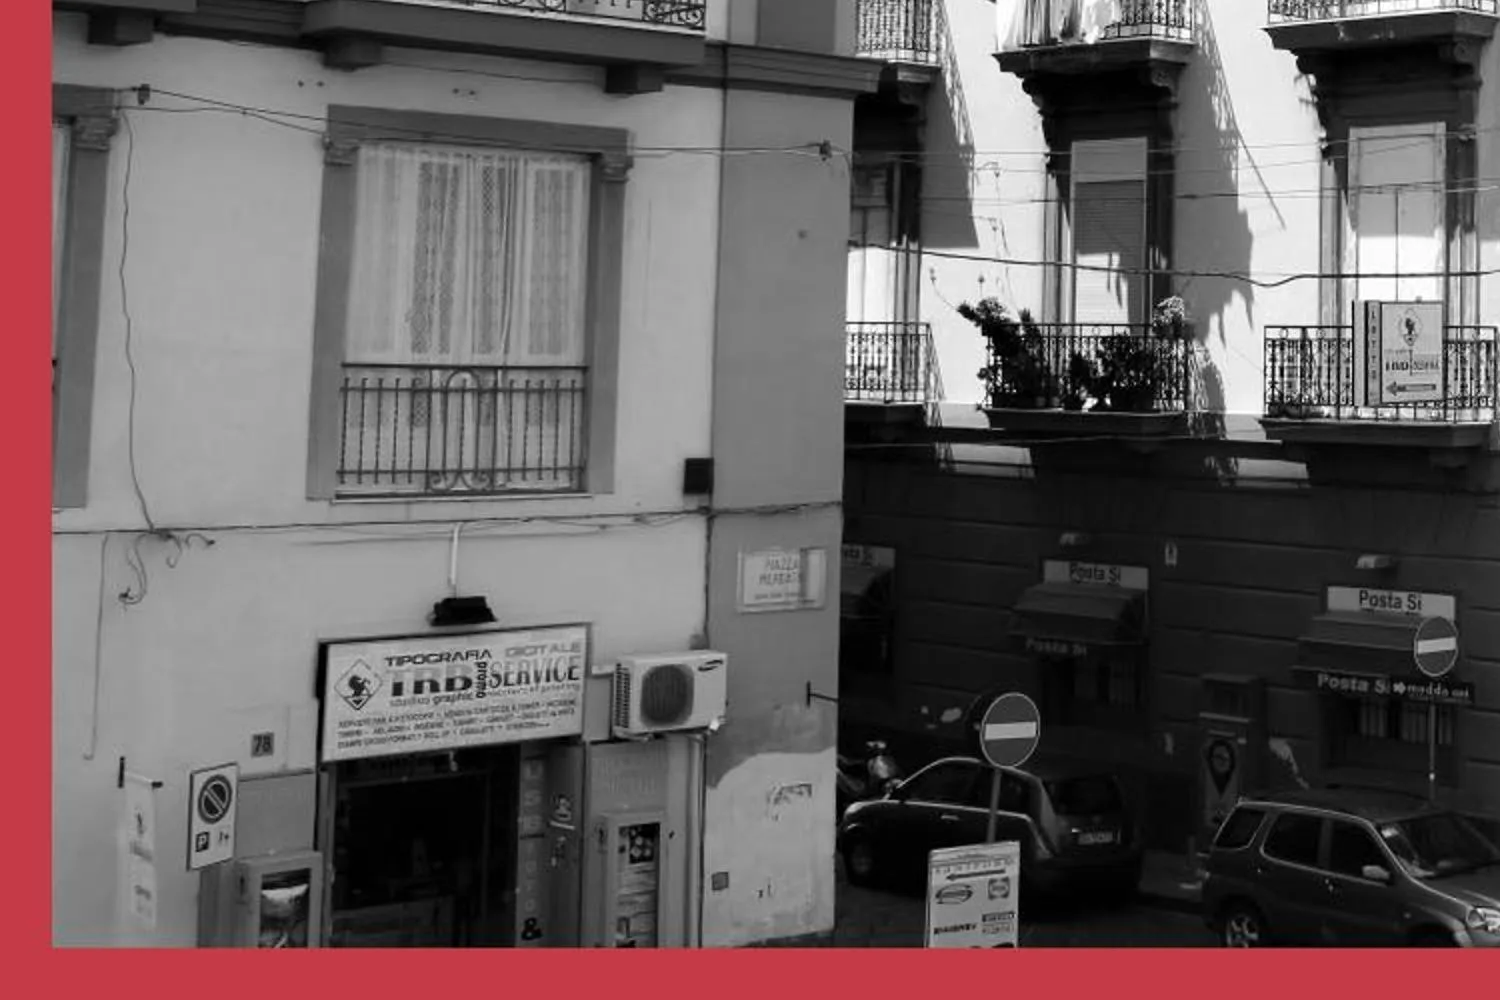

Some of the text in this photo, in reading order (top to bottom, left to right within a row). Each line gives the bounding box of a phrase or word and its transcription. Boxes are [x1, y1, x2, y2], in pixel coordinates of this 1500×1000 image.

[1069, 563, 1106, 582] Posta
[1359, 590, 1402, 610] Posta
[384, 649, 493, 667] TIPOGRAFIA
[488, 655, 582, 689] SERVICE
[1317, 673, 1370, 692] Posta
